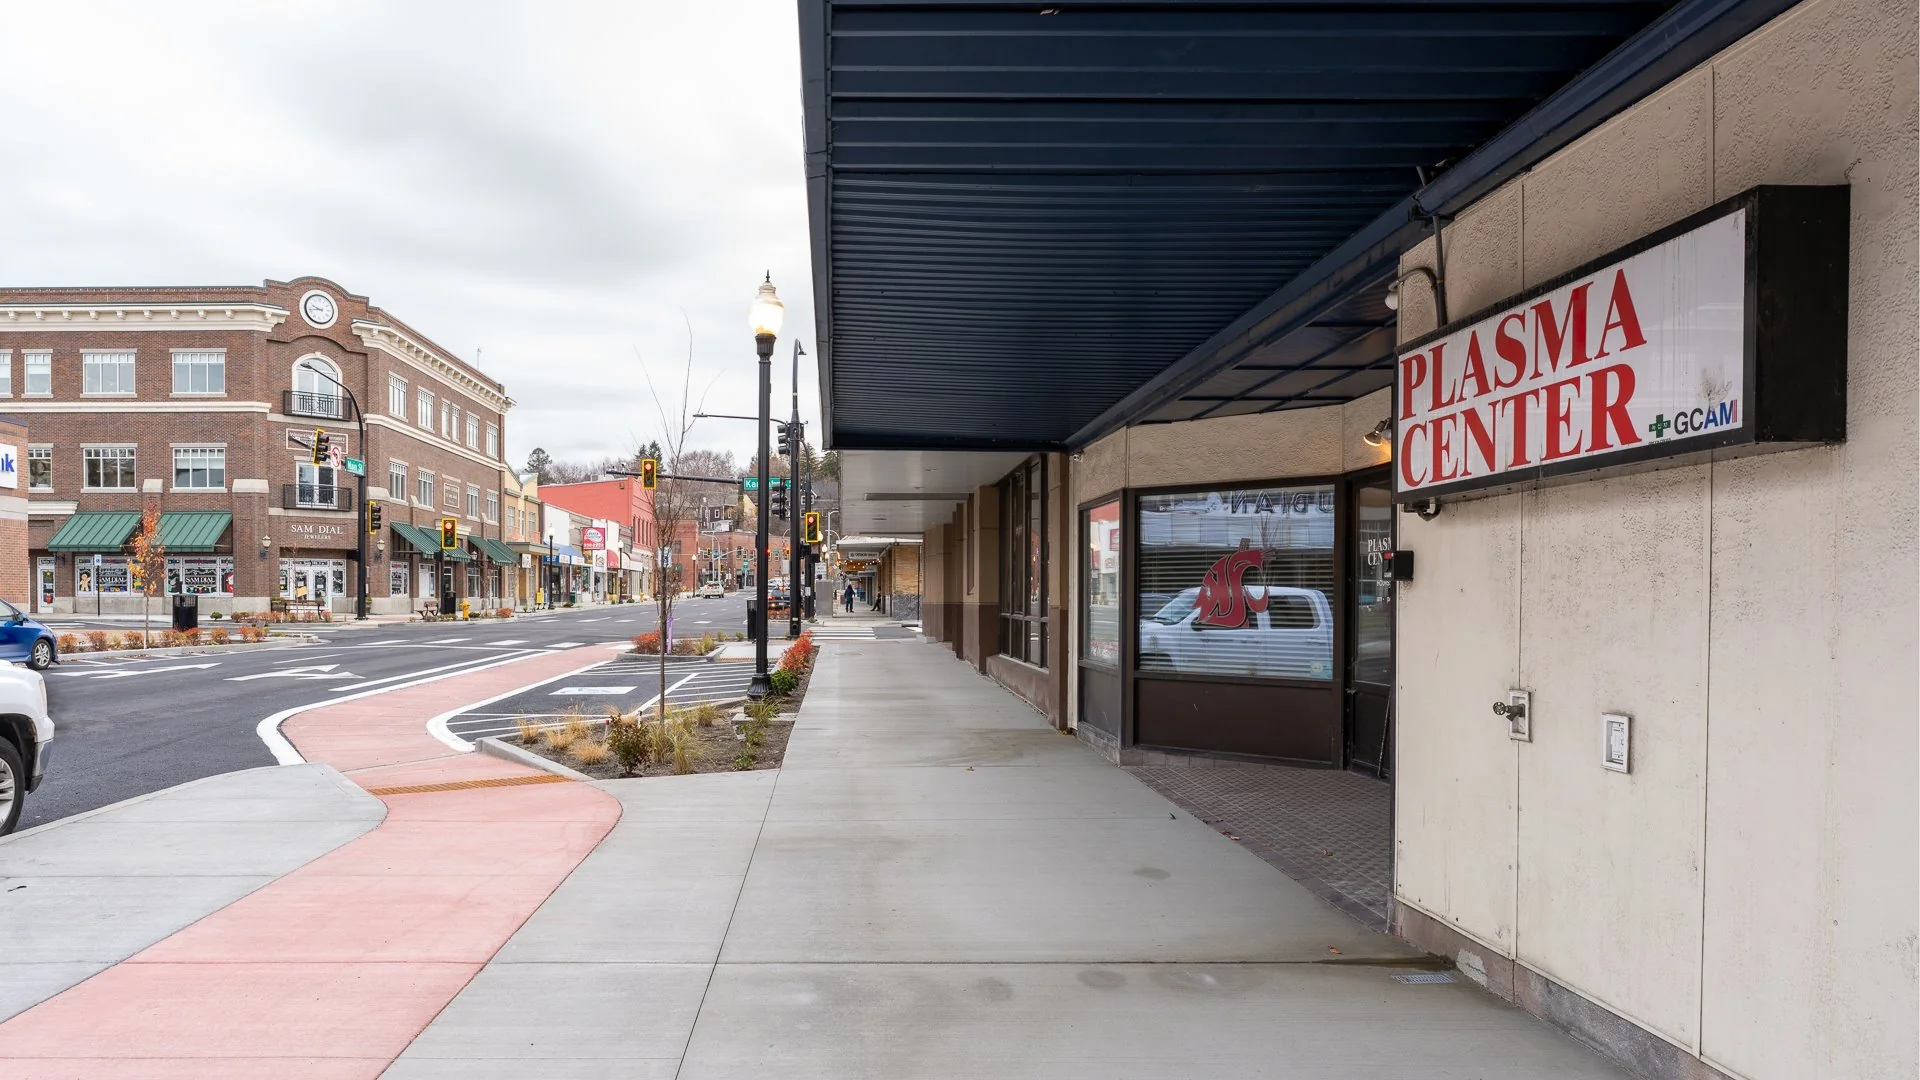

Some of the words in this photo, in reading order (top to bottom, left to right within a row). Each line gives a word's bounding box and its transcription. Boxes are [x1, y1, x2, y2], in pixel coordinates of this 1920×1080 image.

[1400, 268, 1647, 421] PLASMA
[1401, 363, 1642, 487] CENTER
[1674, 400, 1737, 435] GCAM
[347, 460, 357, 471] Main
[291, 524, 313, 533] SAM
[318, 525, 343, 534] DIAL
[1368, 552, 1383, 566] CEN
